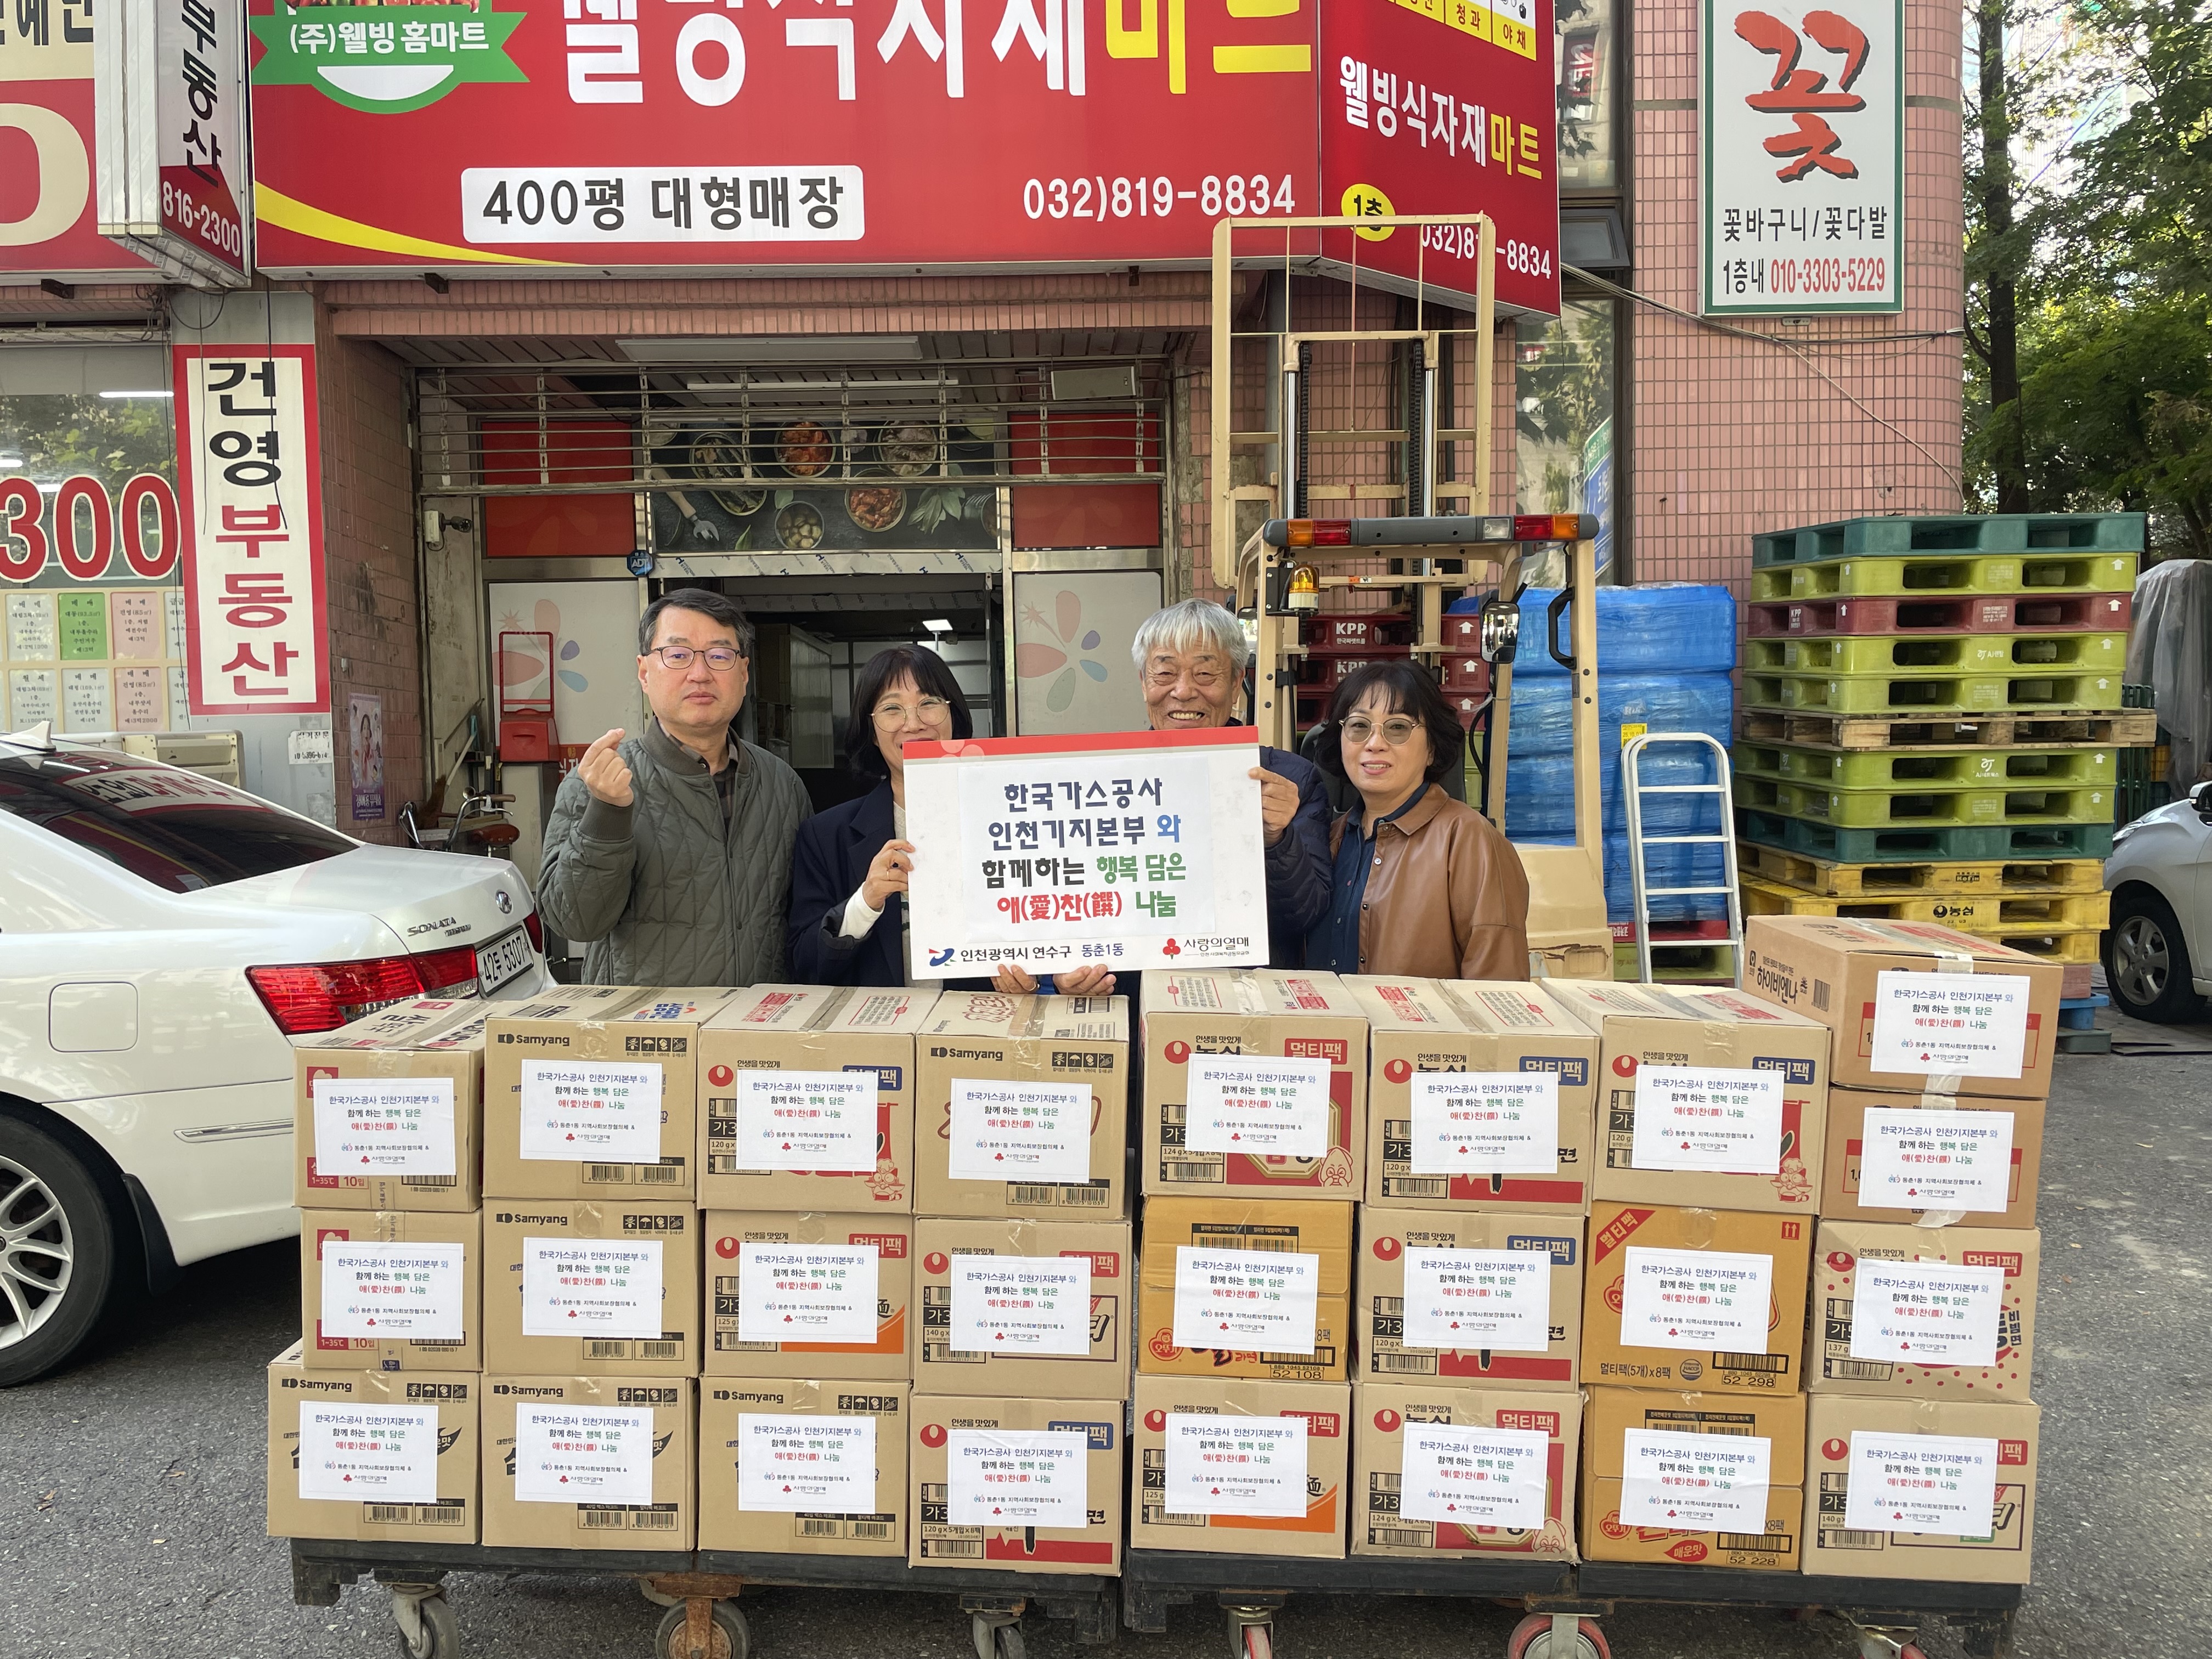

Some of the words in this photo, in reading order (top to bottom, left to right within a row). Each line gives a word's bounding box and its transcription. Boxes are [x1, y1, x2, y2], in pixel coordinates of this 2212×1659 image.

[289, 21, 394, 54] (주)웰빙
[400, 20, 489, 54] 홈마트
[1503, 24, 1526, 50] 야채
[1734, 10, 1870, 183] 꽃
[1340, 56, 1542, 180] 웰빙식자재마트
[1023, 173, 1296, 222] 032)819-8834
[482, 177, 625, 232] 400평
[651, 176, 844, 230] 대형매장
[162, 180, 240, 258] 816-2300
[1723, 206, 1887, 242] 꽃바구니/꽃다발
[1723, 258, 1765, 295] 1층내
[1771, 257, 1886, 294] 010-3303-5229
[631, 558, 650, 569] ADT
[1336, 623, 1367, 635] KPP
[1004, 778, 1163, 813] 한국가스공사
[988, 816, 1146, 851] 인천기지본부
[1157, 814, 1181, 844] 와
[981, 858, 1085, 889] 함께하는
[1097, 856, 1137, 885] 행복
[1145, 852, 1187, 882] 담은
[1136, 890, 1177, 919] 나눔
[1950, 906, 1973, 916] 농심
[407, 917, 456, 936] SONATA
[1184, 936, 1250, 952] 사랑의열매
[960, 946, 1029, 963] 인천광역시
[1032, 945, 1073, 960] 연수구
[1081, 942, 1125, 959] 동춘1동
[483, 952, 502, 984] 42두
[501, 935, 525, 972] 5307
[1757, 966, 1798, 1005] 하이비엔나
[1894, 990, 1945, 1000] 한국가스공사
[1950, 992, 2002, 1002] 인천기지본부
[2005, 994, 2013, 1003] 와
[1912, 1005, 1929, 1013] 함께
[1932, 1005, 1949, 1013] 하는
[1954, 1006, 1971, 1014] 행복
[1976, 1007, 1993, 1015] 담은
[1970, 1020, 1987, 1029] 나눔
[516, 1034, 569, 1046] Samyang
[1219, 1036, 1241, 1045] 맛있게
[950, 1048, 1003, 1061] Samyang
[1418, 1053, 1441, 1062] 인생을
[1443, 1054, 1466, 1063] 맛있게
[737, 1060, 758, 1068] 인생을
[760, 1060, 780, 1068] 맛있게
[538, 1073, 585, 1082] 한국가스공사
[589, 1074, 637, 1084] 인천기지본부
[555, 1086, 571, 1094] 함께
[593, 1087, 608, 1096] 행복
[343, 1176, 365, 1187] 10입
[515, 1214, 567, 1226] Samyang
[1599, 1212, 1639, 1249] 멀티팩
[1407, 1232, 1429, 1240] 인생을
[1431, 1233, 1455, 1242] 맛있게
[1860, 1248, 1881, 1256] 인생을
[1883, 1249, 1905, 1258] 맛있게
[967, 1273, 1014, 1282] 한국가스공사
[1019, 1274, 1066, 1283] 인천기지본부
[1069, 1276, 1077, 1284] 와
[985, 1286, 1000, 1294] 함께
[1042, 1288, 1058, 1296] 담은
[2008, 1310, 2022, 1346] 비빔면
[354, 1338, 375, 1348] 10입
[1235, 1351, 1257, 1363] 라면
[1273, 1370, 1290, 1379] 52
[1297, 1370, 1322, 1379] 108
[1723, 1375, 1741, 1385] 52
[1748, 1376, 1774, 1386] 298
[300, 1380, 352, 1393] Samyang
[511, 1387, 563, 1397] Samyang
[732, 1391, 784, 1403] Samyang
[951, 1418, 973, 1427] 인생을
[975, 1419, 998, 1428] 맛있게
[1502, 1414, 1554, 1434] 멀티팩
[1420, 1441, 1469, 1453] 한국가스공사
[1474, 1445, 1523, 1457] 인천기지본부
[1525, 1449, 1533, 1457] 와
[1438, 1456, 1453, 1465] 함께
[1456, 1458, 1472, 1466] 하는
[1477, 1459, 1493, 1468] 행복
[1498, 1460, 1514, 1469] 담은
[1493, 1474, 1509, 1482] 나눔
[1605, 1525, 1627, 1533] 오뚜기
[1674, 1544, 1702, 1557] 매운맛
[1730, 1556, 1748, 1565] 52
[1751, 1557, 1776, 1566] 228
